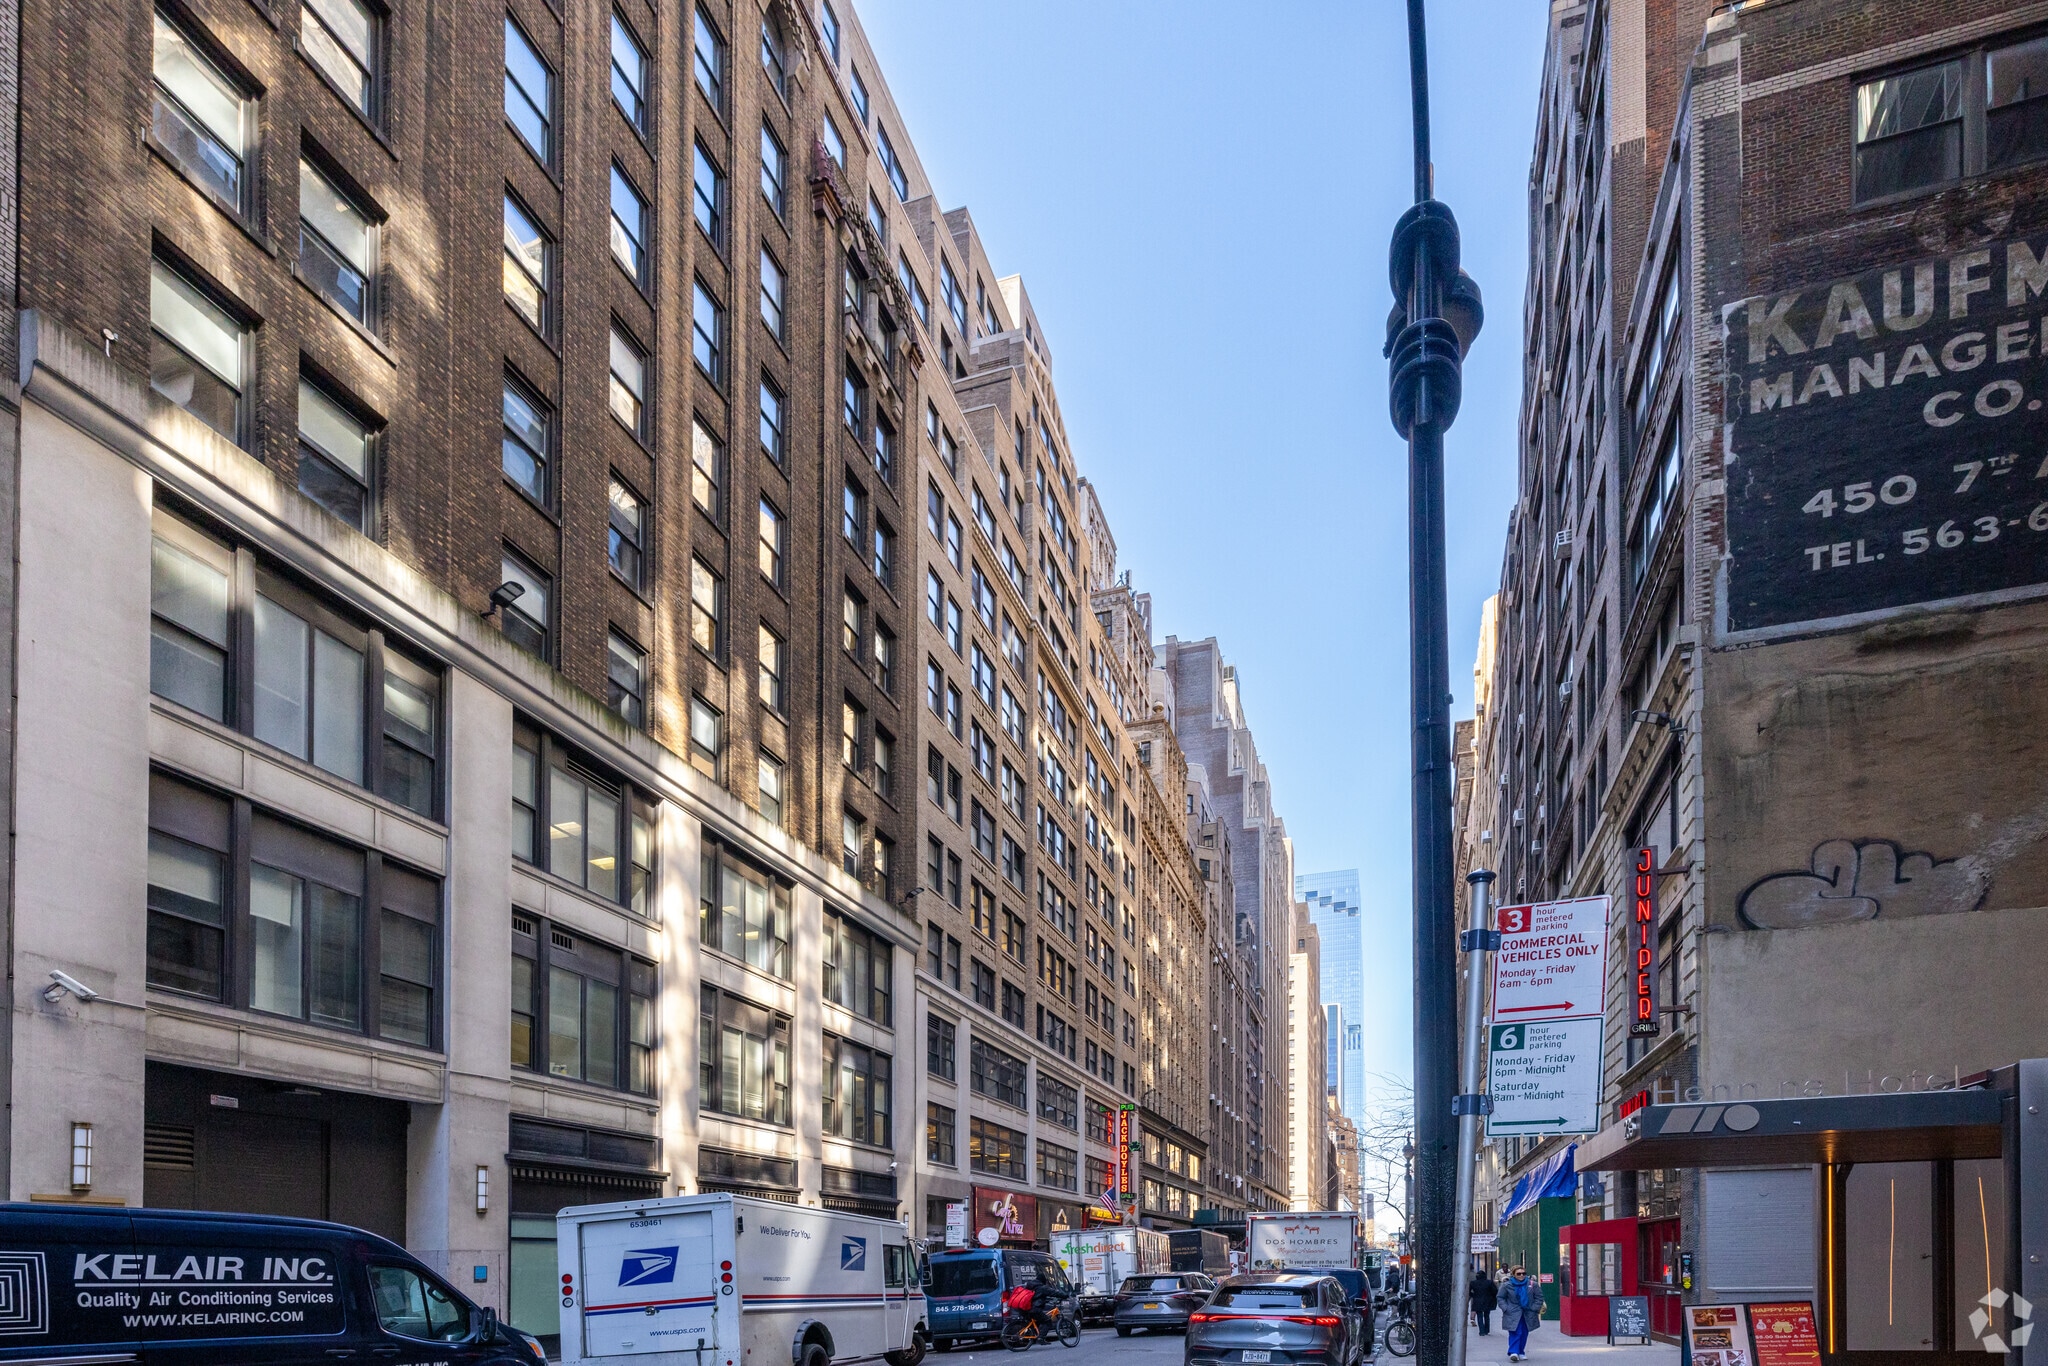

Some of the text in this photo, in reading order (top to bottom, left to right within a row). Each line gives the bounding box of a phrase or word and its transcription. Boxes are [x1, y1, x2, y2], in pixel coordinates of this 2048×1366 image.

[1748, 241, 2048, 364] KAUFM
[1750, 316, 2048, 415] MANAGE
[1922, 379, 2042, 427] CO.
[1802, 475, 1917, 518] 450
[1804, 539, 1885, 571] TEL.
[1536, 907, 1556, 915] hour
[1536, 913, 1573, 923] metered
[1506, 910, 1524, 932] 3
[1536, 922, 1568, 932] parking
[1502, 934, 1585, 950] COMMERCIAL
[1636, 850, 1651, 1020] JUNIPER
[1502, 944, 1599, 964] VEHICLES ONLY
[1500, 967, 1537, 978] Monday
[1546, 964, 1576, 974] Friday
[1500, 980, 1522, 988] 6am
[1530, 977, 1552, 988] 6pm
[1530, 1026, 1550, 1034] hour
[1632, 1024, 1658, 1033] GRILL
[1500, 1026, 1518, 1048] 6
[1530, 1032, 1566, 1042] metered
[1530, 1040, 1562, 1050] parking
[1495, 1057, 1534, 1068] Monday
[1544, 1054, 1576, 1064] Friday
[1494, 1066, 1516, 1078] 6pm
[1525, 1064, 1566, 1076] Midnight
[1494, 1082, 1540, 1092] Saturday
[1779, 1080, 1824, 1099] na
[1845, 1065, 1959, 1096] Hotel
[1494, 1092, 1515, 1102] 8am
[1524, 1090, 1564, 1102] Midnight
[630, 1220, 662, 1228] 6530461
[760, 1226, 770, 1234] We
[770, 1226, 790, 1236] Deliver
[791, 1229, 800, 1238] For
[1062, 1241, 1125, 1255] freshdirect
[73, 1253, 334, 1281] KELAIR INC.
[77, 1290, 334, 1309] Quality Air Conditioning Services
[123, 1311, 304, 1327] WWW.KELAIRINC.COM
[650, 1327, 705, 1337] www.usps.com
